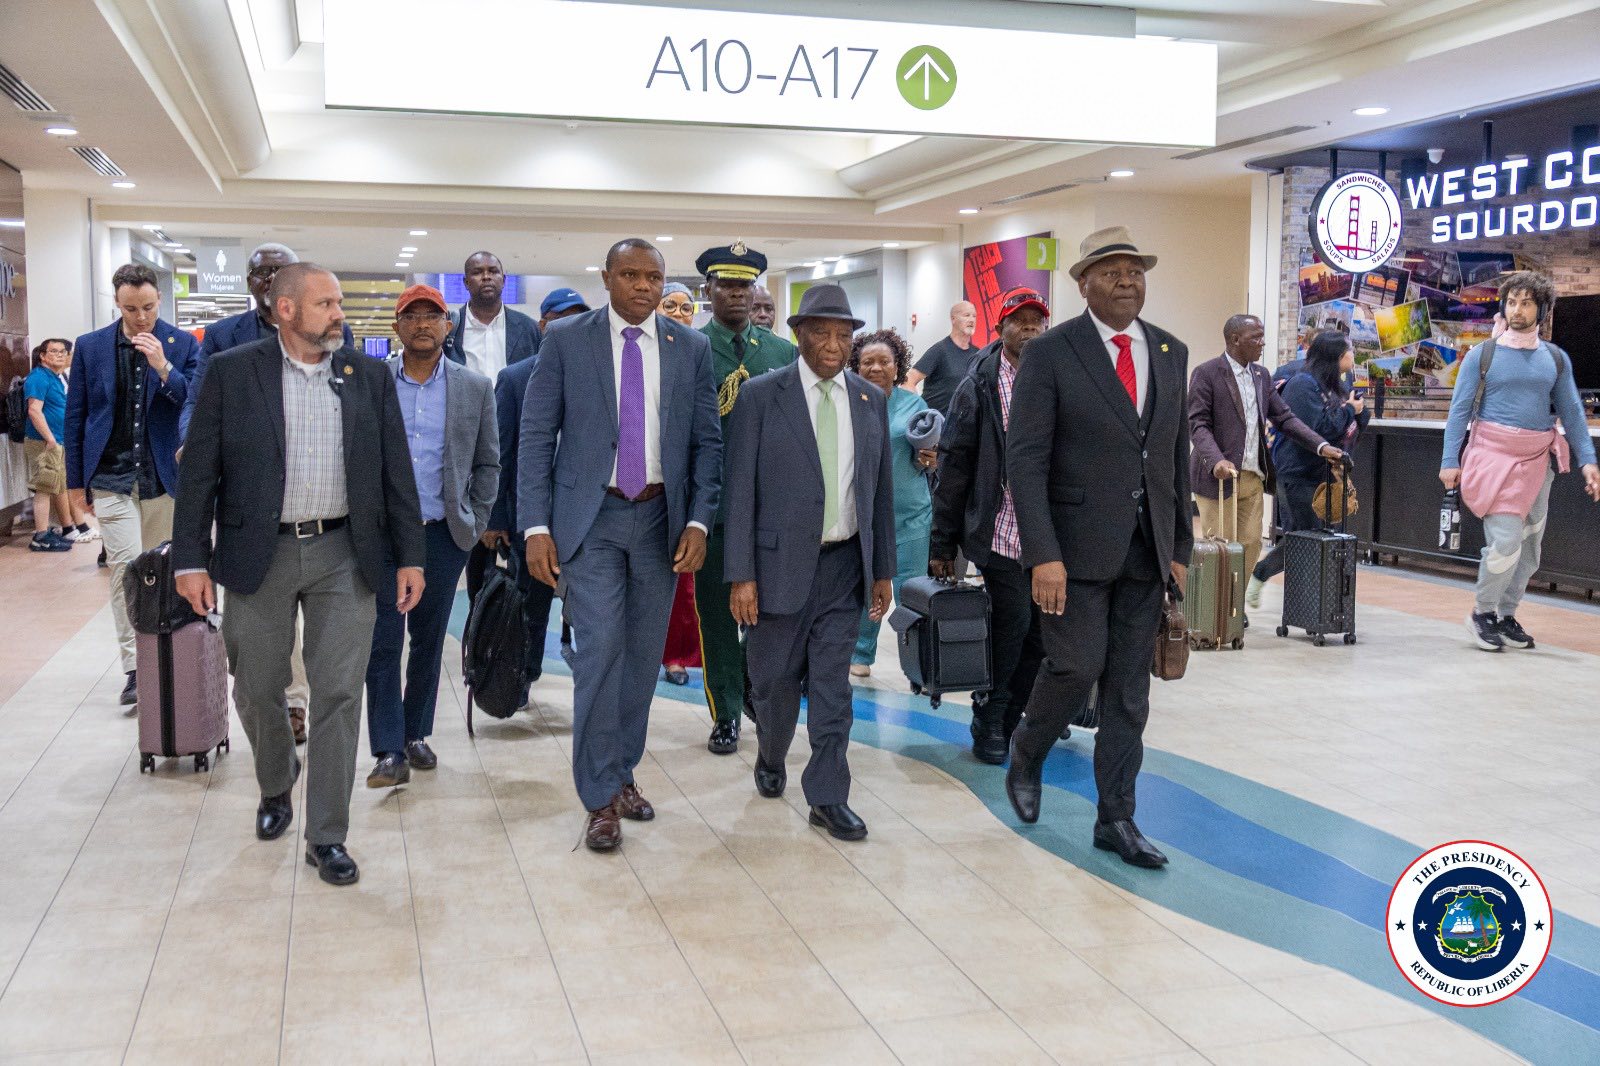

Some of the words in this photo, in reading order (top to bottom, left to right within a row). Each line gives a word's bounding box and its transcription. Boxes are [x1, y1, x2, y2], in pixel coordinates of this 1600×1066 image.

[645, 35, 879, 101] A10-A17
[1336, 175, 1387, 193] SANDWICHES
[1406, 157, 1529, 210] WEST
[1431, 195, 1598, 244] SOURDO
[1323, 239, 1344, 263] SOUPS
[1371, 237, 1396, 264] SALADS
[202, 271, 242, 283] Women
